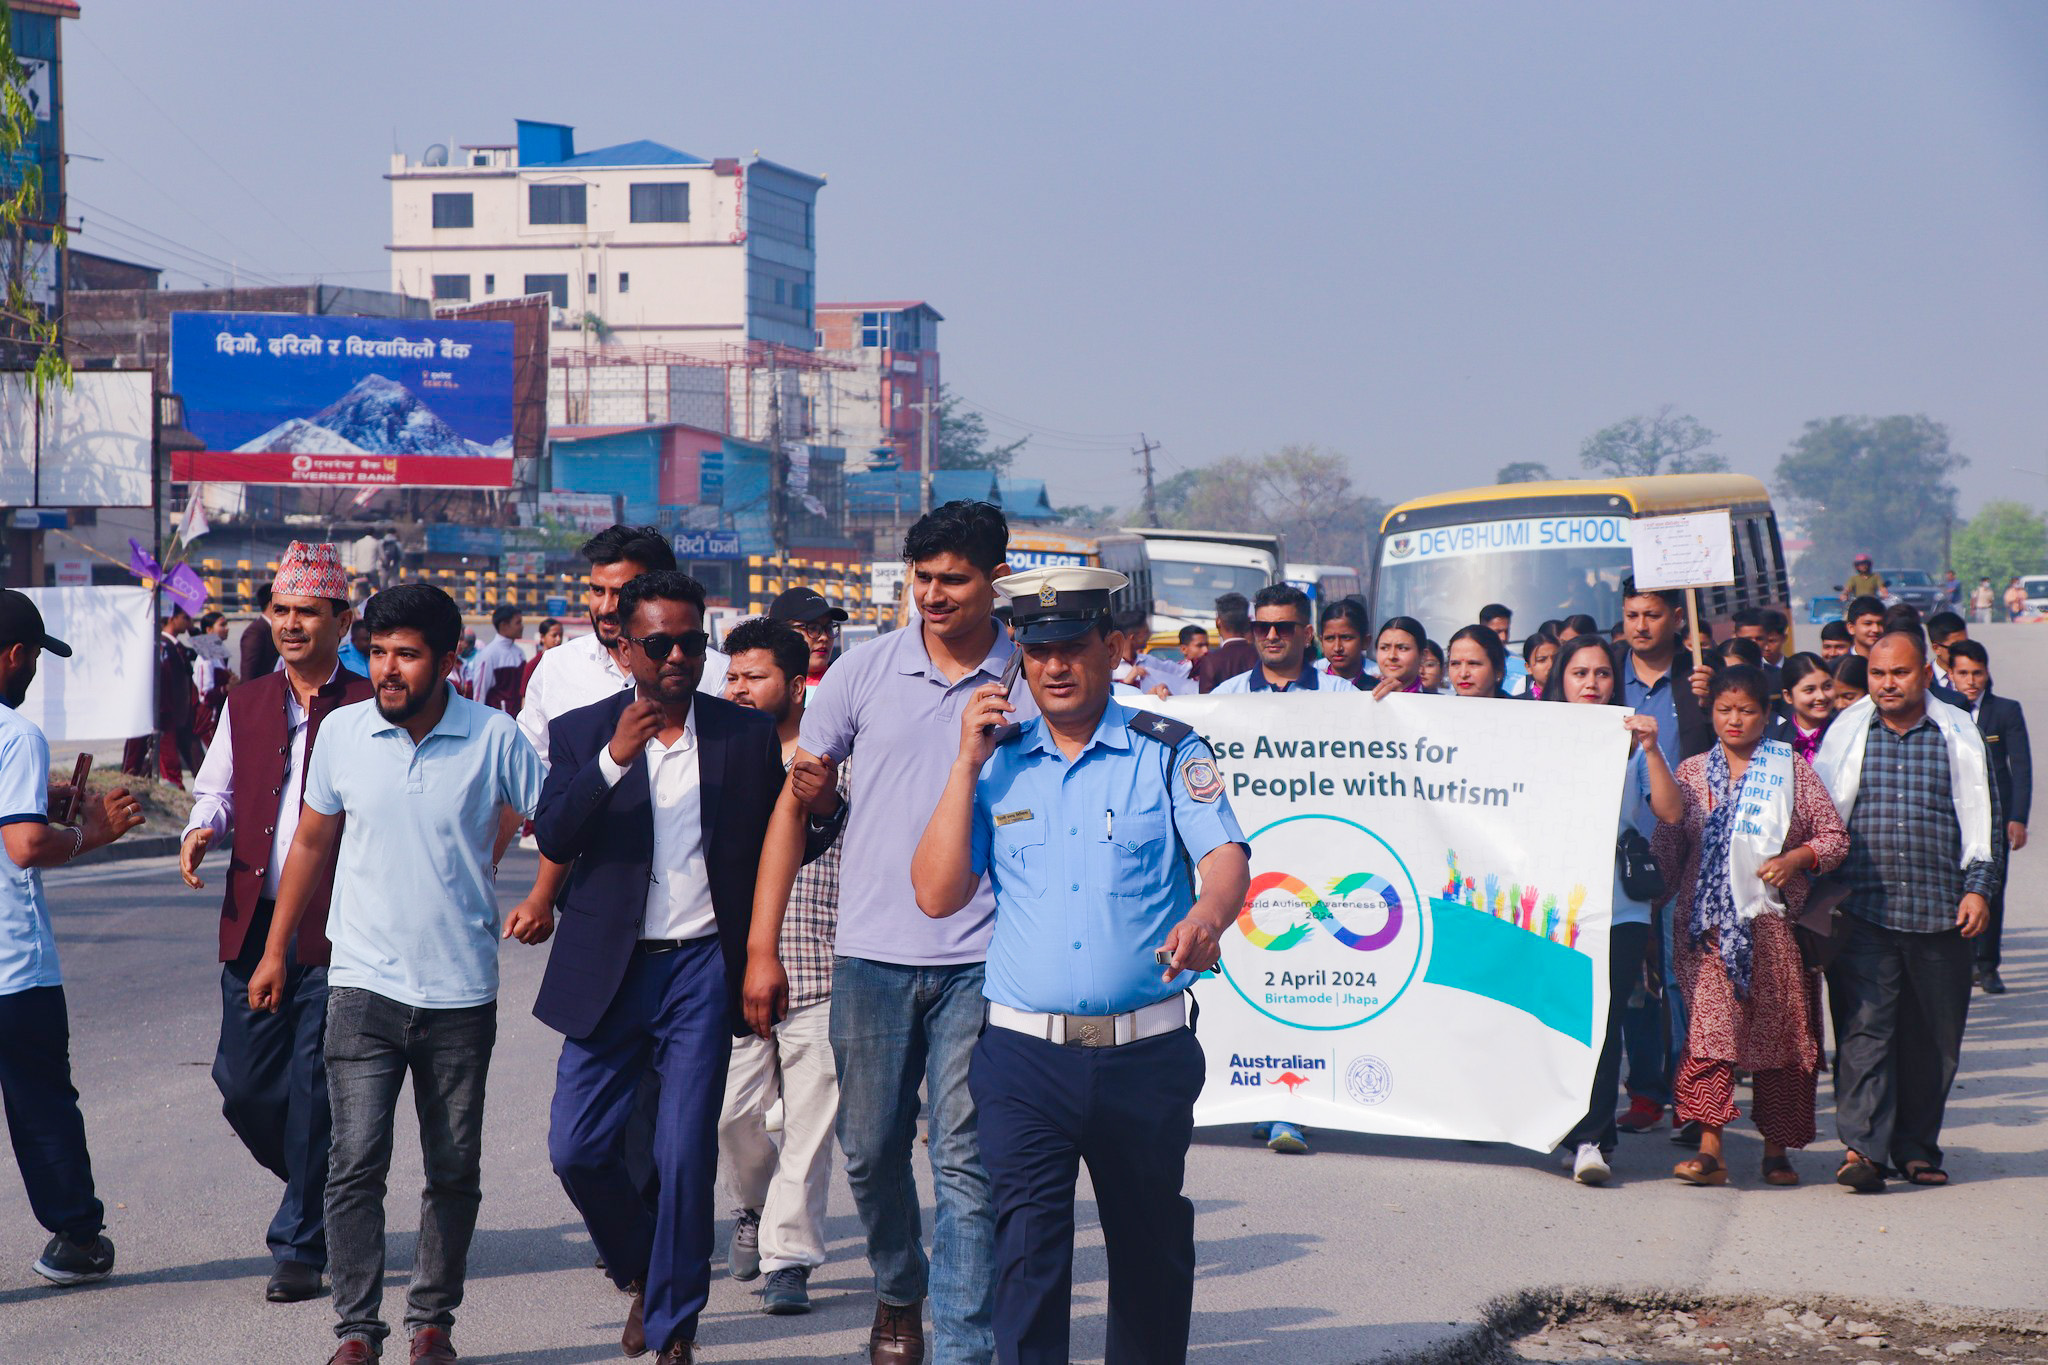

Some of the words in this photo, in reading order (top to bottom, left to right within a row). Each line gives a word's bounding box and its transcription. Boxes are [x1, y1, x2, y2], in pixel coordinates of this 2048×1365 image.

[216, 332, 262, 356] दिगो,
[268, 333, 324, 357] दरिलो
[328, 339, 342, 356] र
[346, 335, 436, 359] विश्वासिलो
[440, 337, 472, 359] बैंक
[292, 471, 354, 481] EVEREST
[357, 472, 397, 482] BANK
[1420, 522, 1530, 555] DEVBHUMI
[1540, 519, 1626, 544] SCHOOL
[1006, 552, 1080, 569] COLLEGE
[1253, 736, 1408, 760] Awareness
[1415, 736, 1458, 764] for
[1747, 770, 1767, 783] HTS
[1233, 771, 1335, 802] People
[1343, 771, 1406, 797] with
[1413, 776, 1524, 807] Autism"
[1744, 786, 1773, 801] OPLE
[1272, 900, 1311, 908] Autism
[1316, 900, 1376, 908] Awareness
[1305, 912, 1334, 920] 2024
[1264, 971, 1275, 986] 2
[1281, 970, 1326, 990] April
[1332, 971, 1377, 987] 2024
[1265, 993, 1333, 1004] Birtamode
[1342, 993, 1379, 1007] Jhapa
[1229, 1053, 1326, 1070] Australian
[1230, 1071, 1261, 1086] Aid
